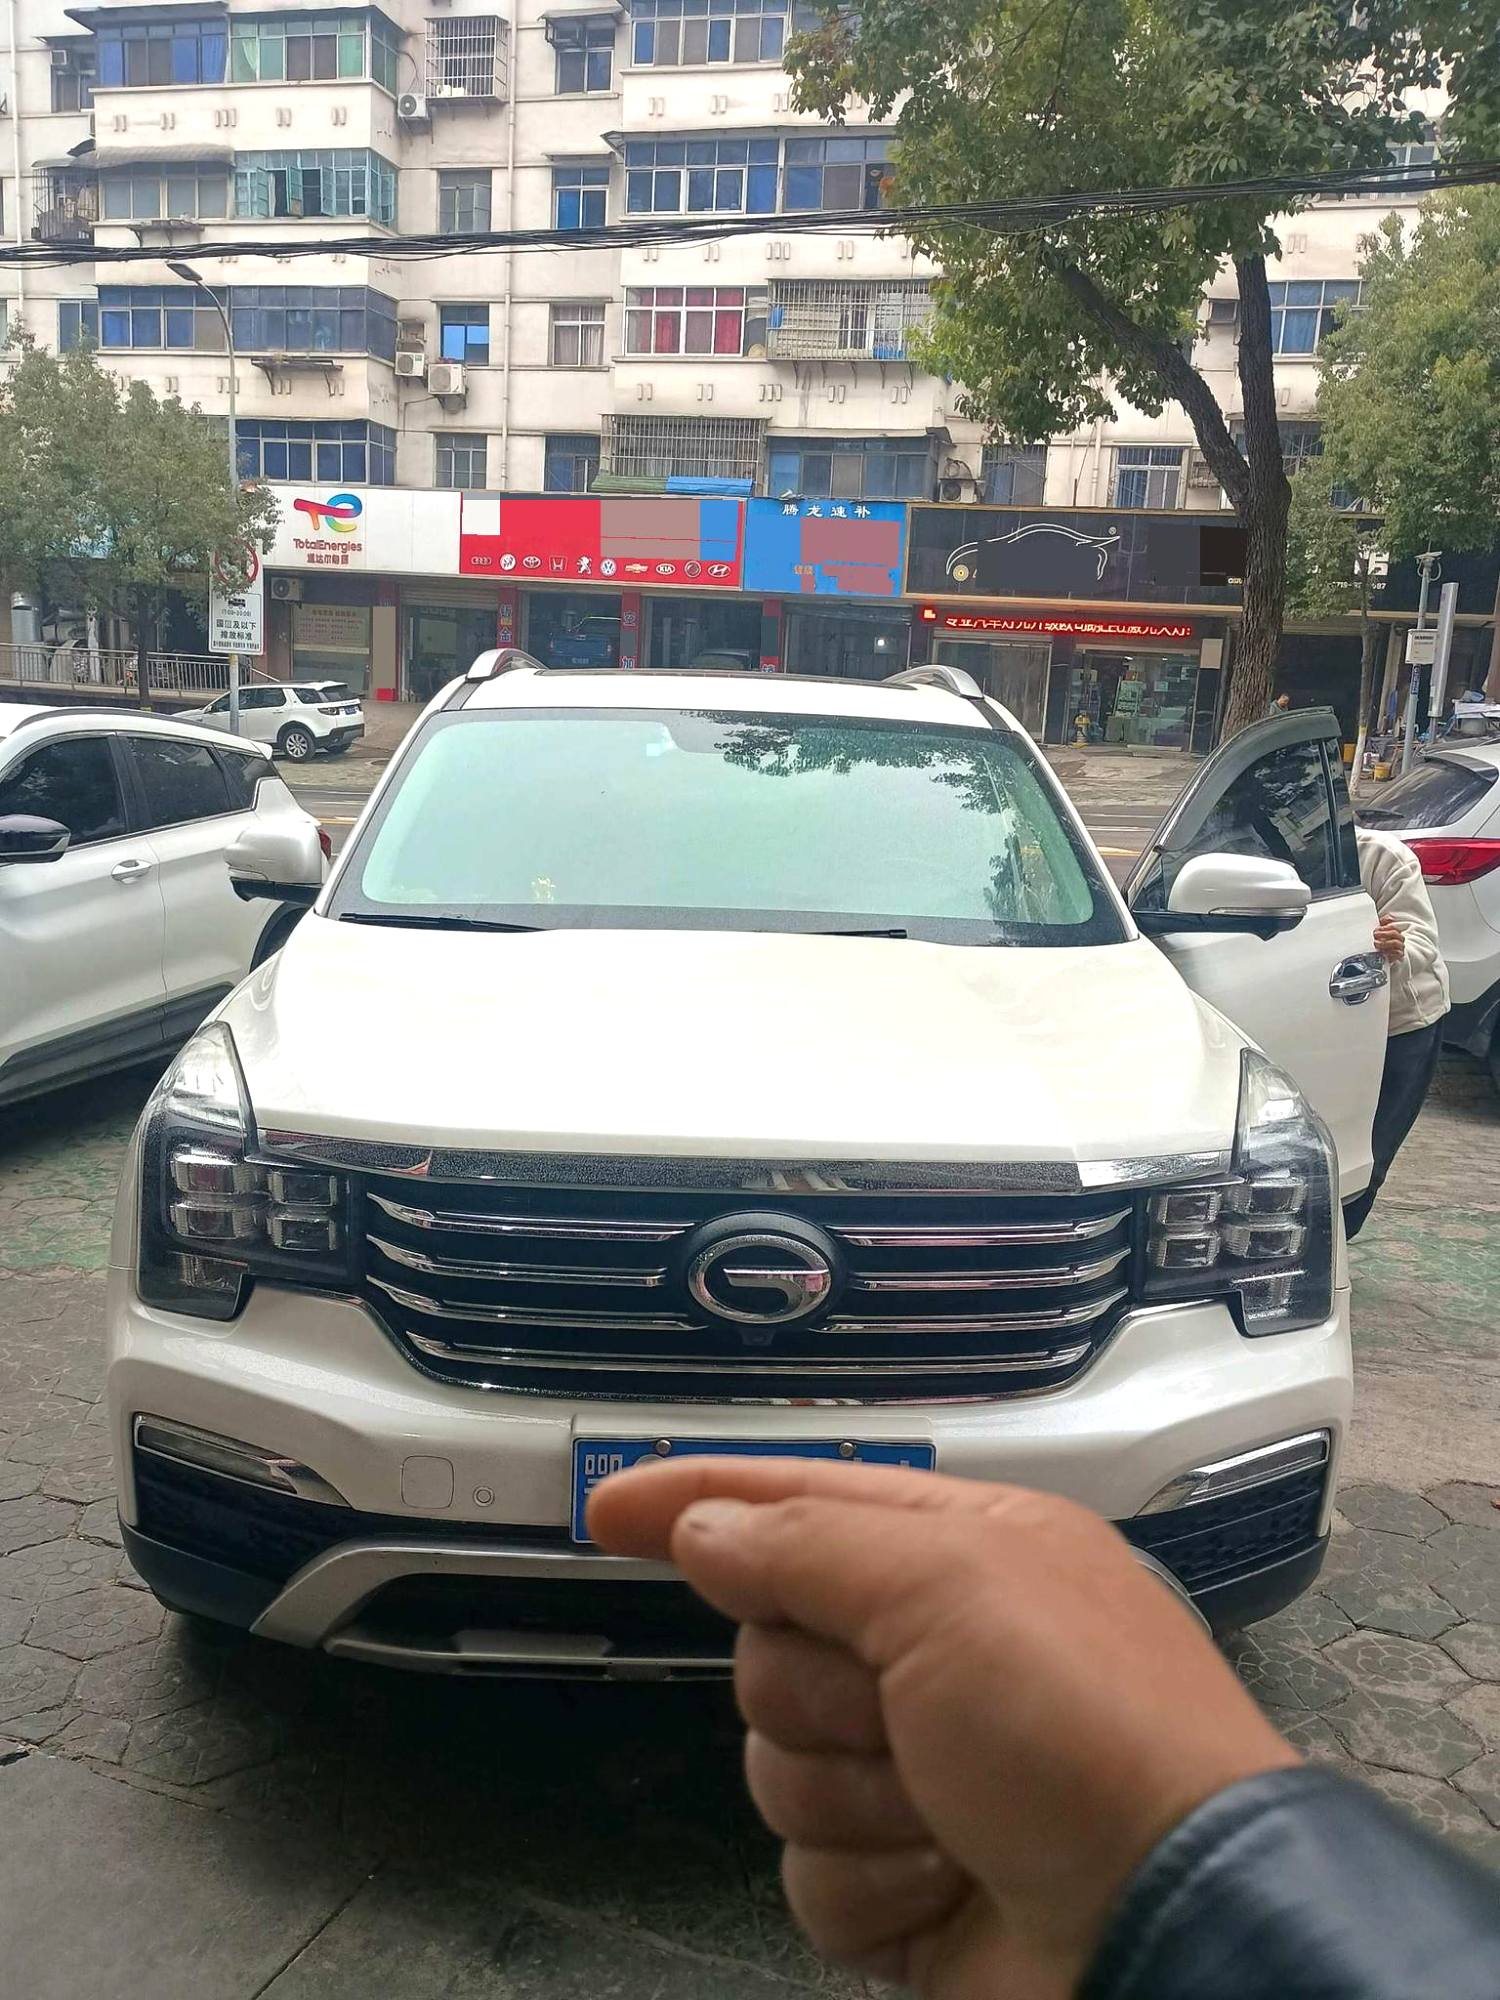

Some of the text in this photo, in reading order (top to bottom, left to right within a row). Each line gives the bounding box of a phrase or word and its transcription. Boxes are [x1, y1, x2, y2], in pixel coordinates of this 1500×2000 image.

[782, 503, 871, 518] 腾龙速补
[293, 538, 362, 554] TotalEnergies
[220, 631, 252, 641] 排放标准
